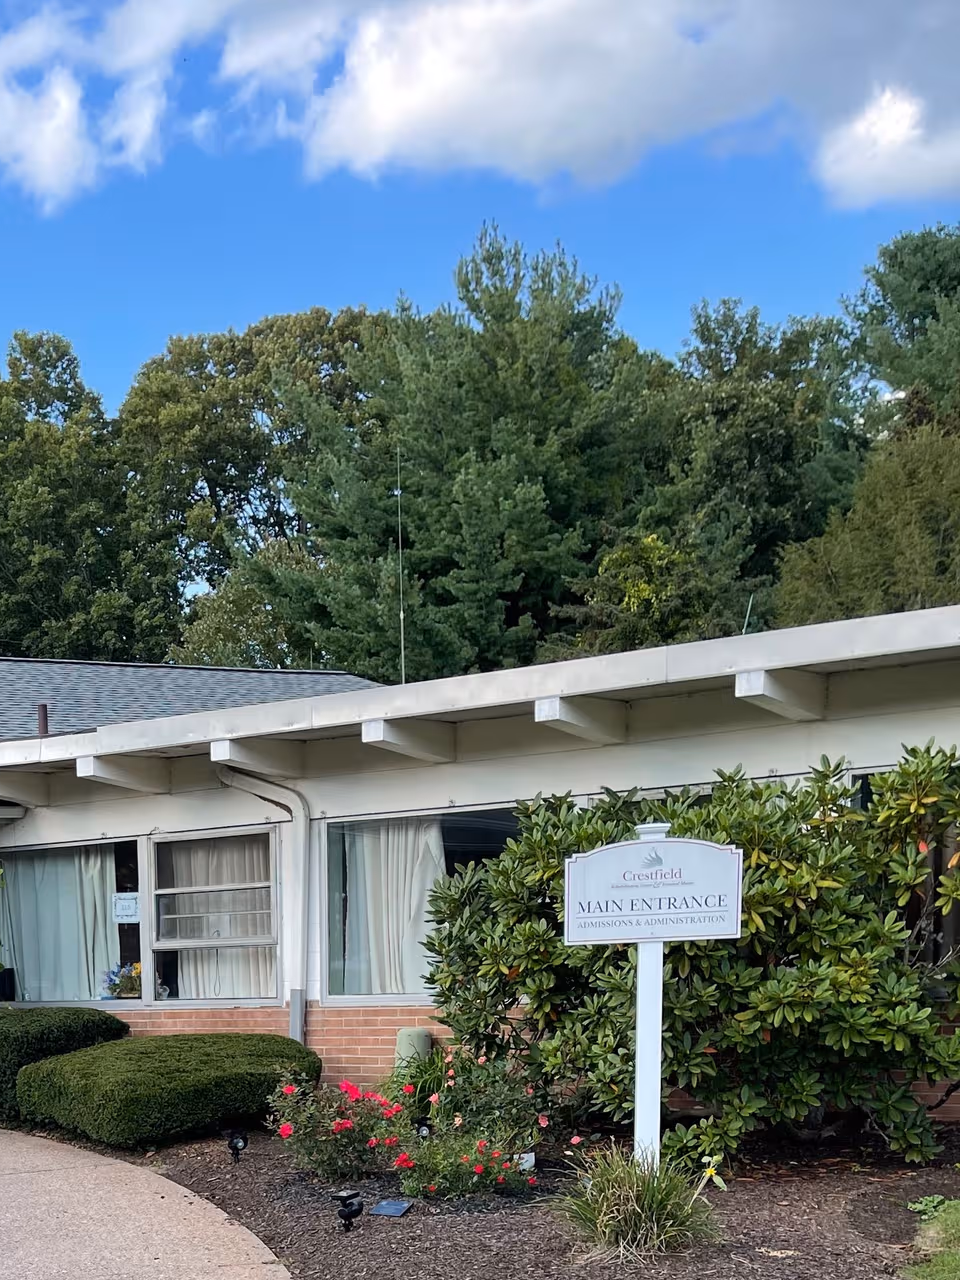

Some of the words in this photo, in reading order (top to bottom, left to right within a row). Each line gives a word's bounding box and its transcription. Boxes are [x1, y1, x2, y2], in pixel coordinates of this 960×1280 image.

[622, 868, 682, 882] Crestfield
[578, 899, 623, 914] MAIN
[630, 894, 728, 912] ENTRANCE
[577, 918, 633, 929] ADMISSIONS
[635, 918, 642, 927] &
[643, 915, 726, 927] ADMINISTRATION
